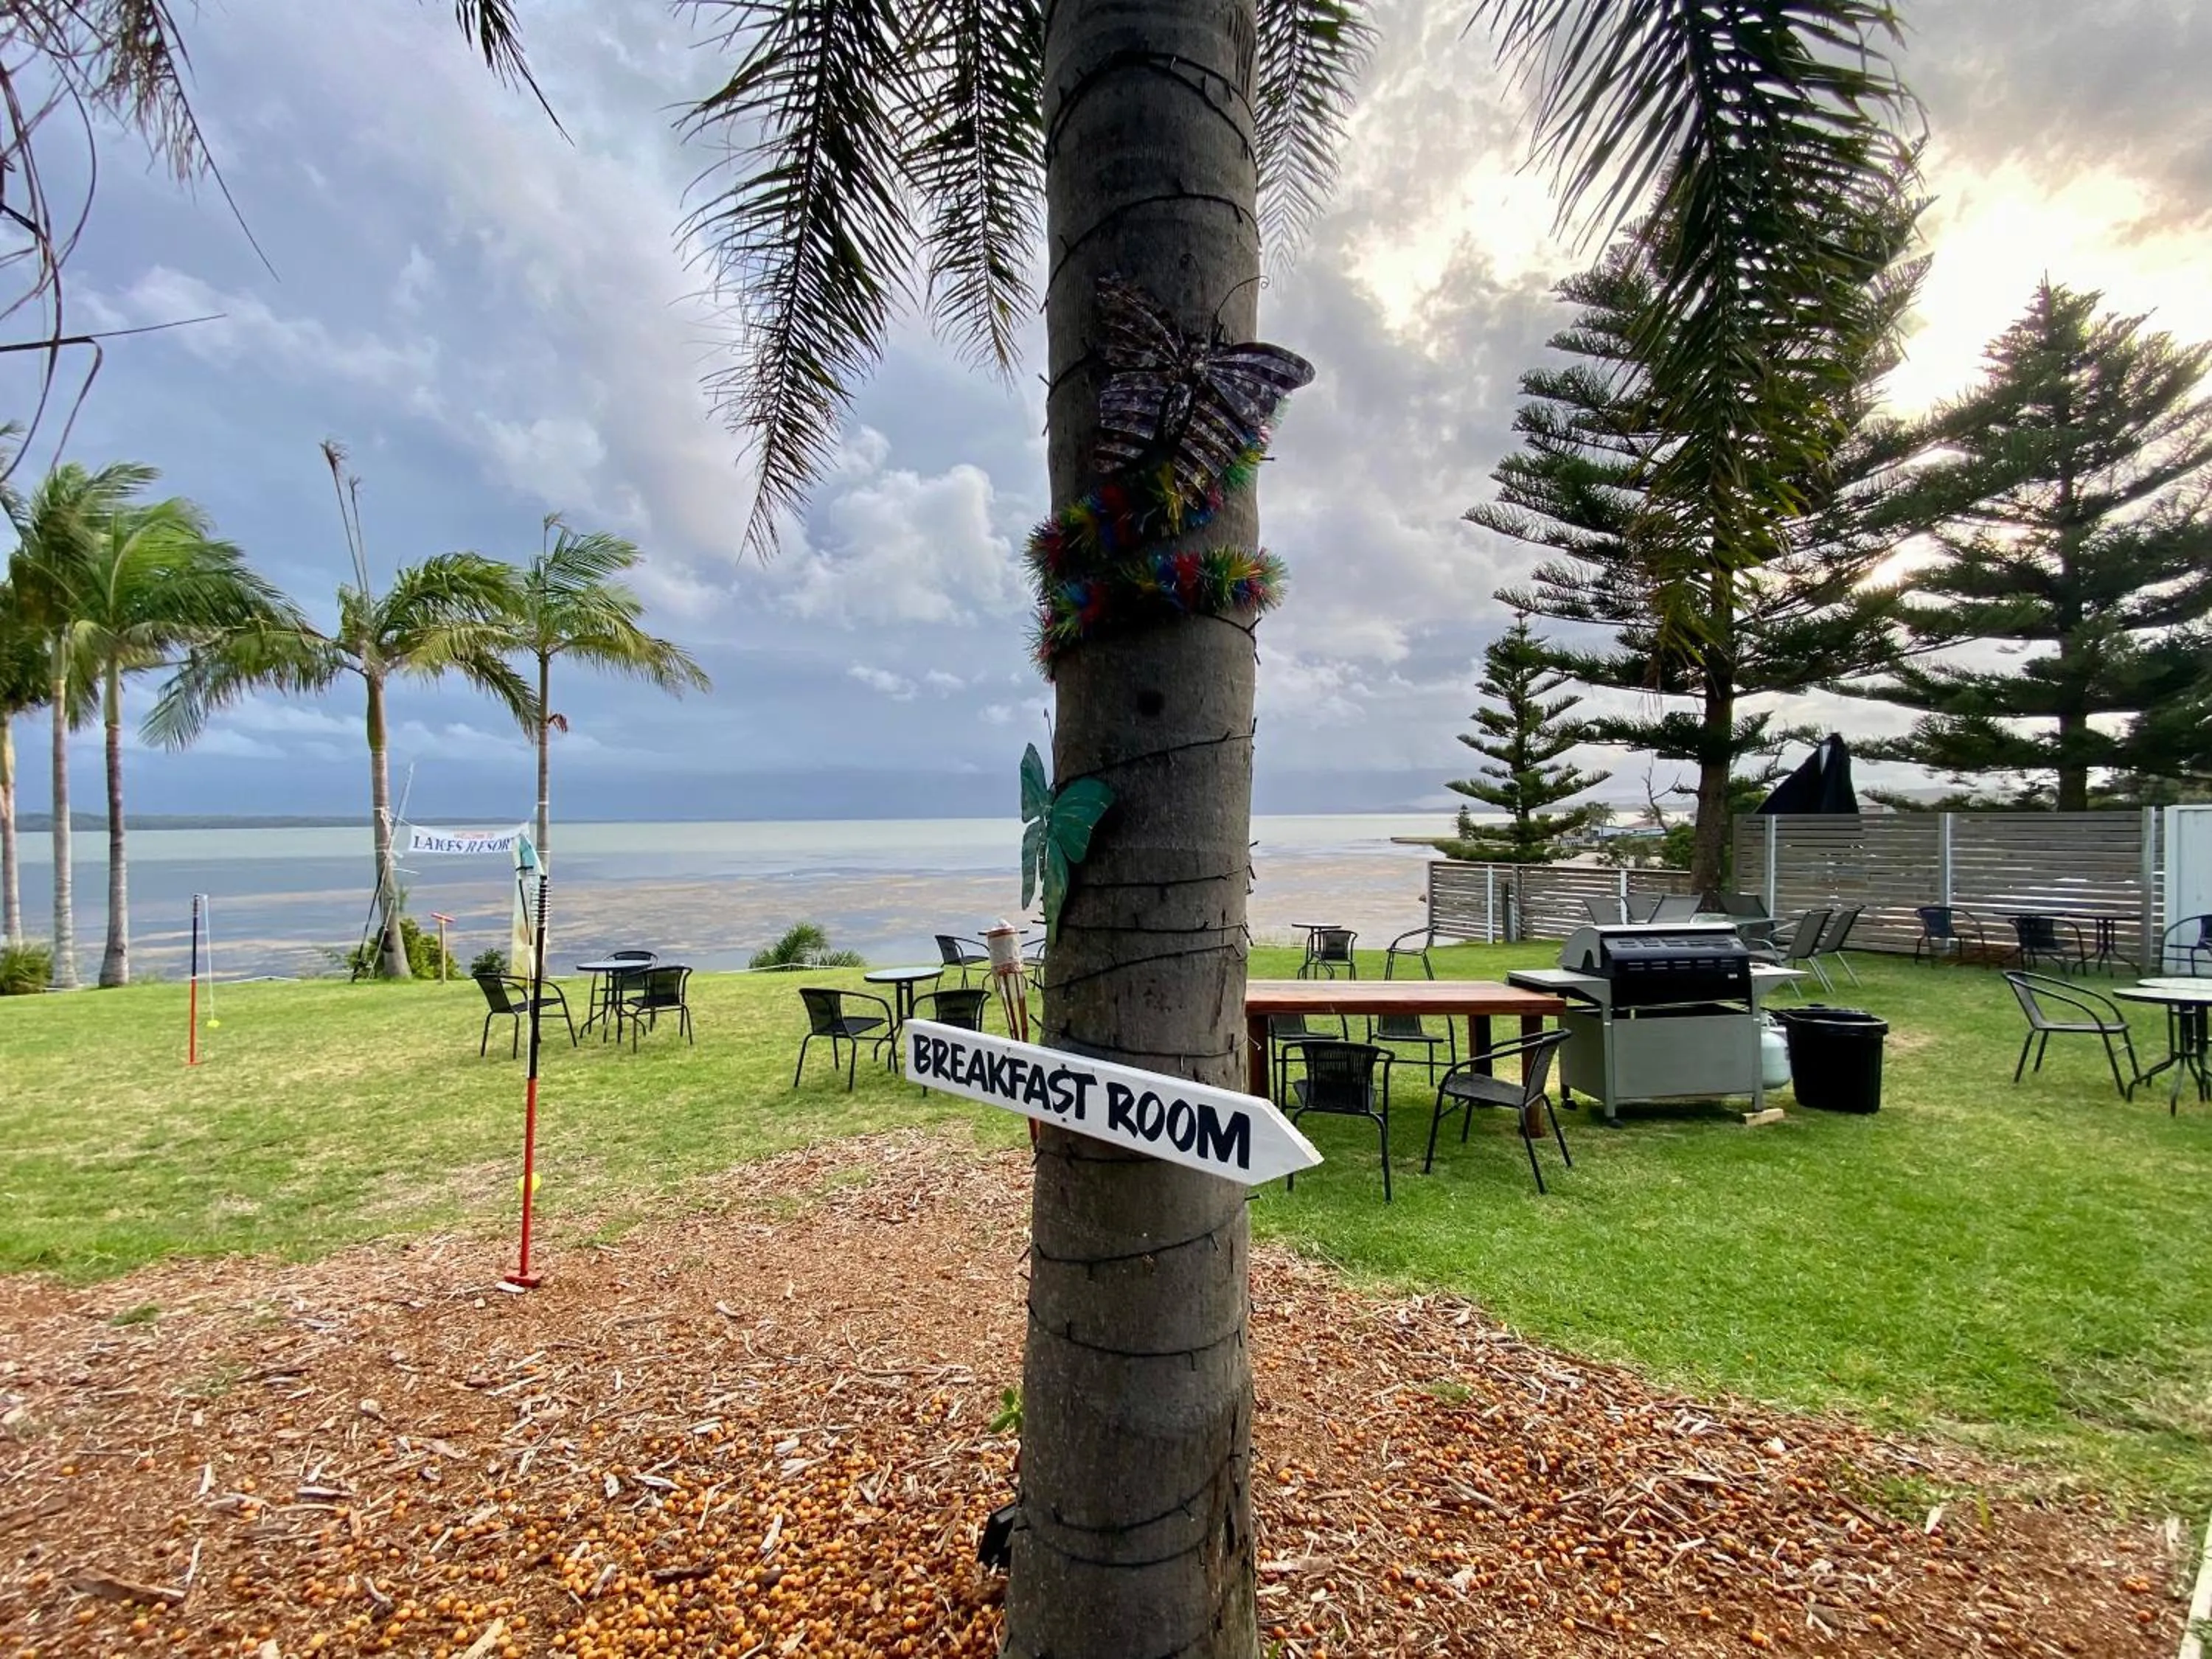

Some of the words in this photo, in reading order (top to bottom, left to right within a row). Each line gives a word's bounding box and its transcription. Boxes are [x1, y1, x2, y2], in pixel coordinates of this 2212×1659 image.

[413, 835, 463, 852] LAKES
[912, 1033, 1097, 1120] BREAKFAST
[1106, 1082, 1251, 1169] ROOM
